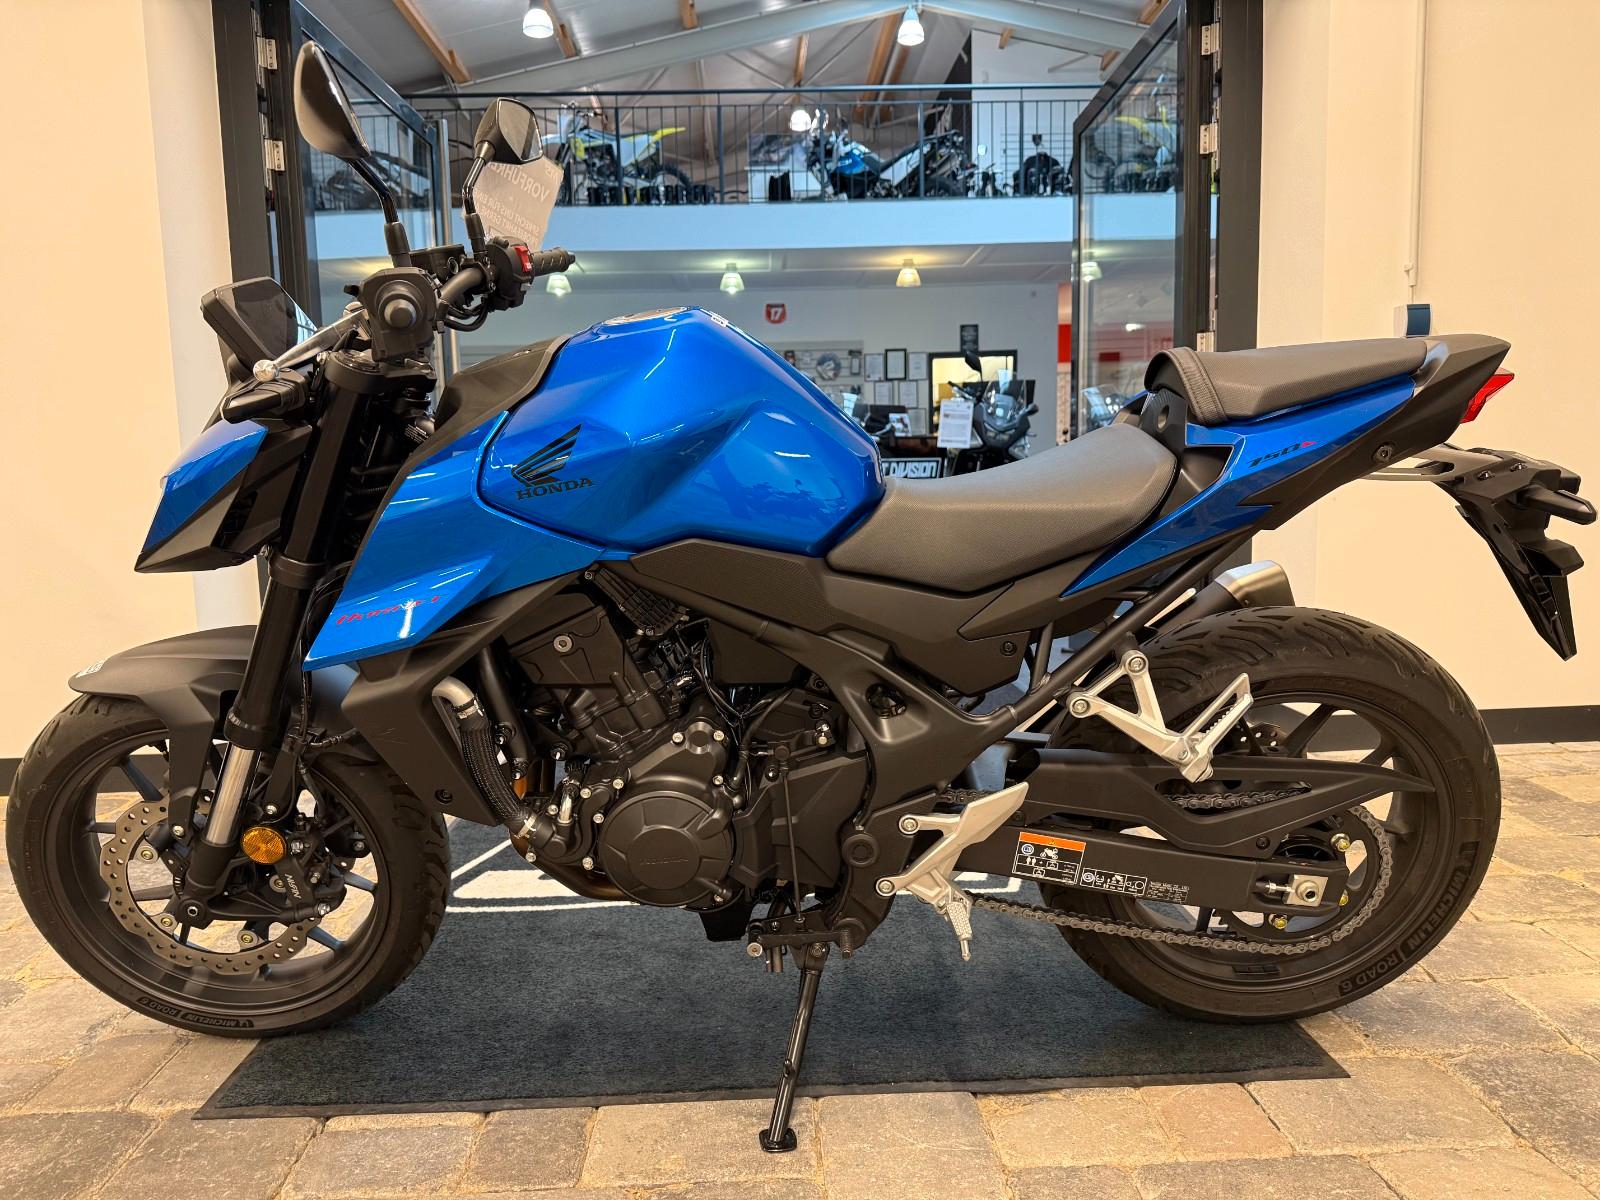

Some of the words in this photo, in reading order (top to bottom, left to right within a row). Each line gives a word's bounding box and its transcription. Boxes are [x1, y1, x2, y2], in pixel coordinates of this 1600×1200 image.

[771, 308, 783, 320] 17
[515, 477, 593, 500] HONDA
[1407, 866, 1467, 951] MICHELIN
[1356, 953, 1399, 984] ROAD
[149, 1001, 178, 1016] ROAD
[185, 1012, 237, 1028] MICHELIN
